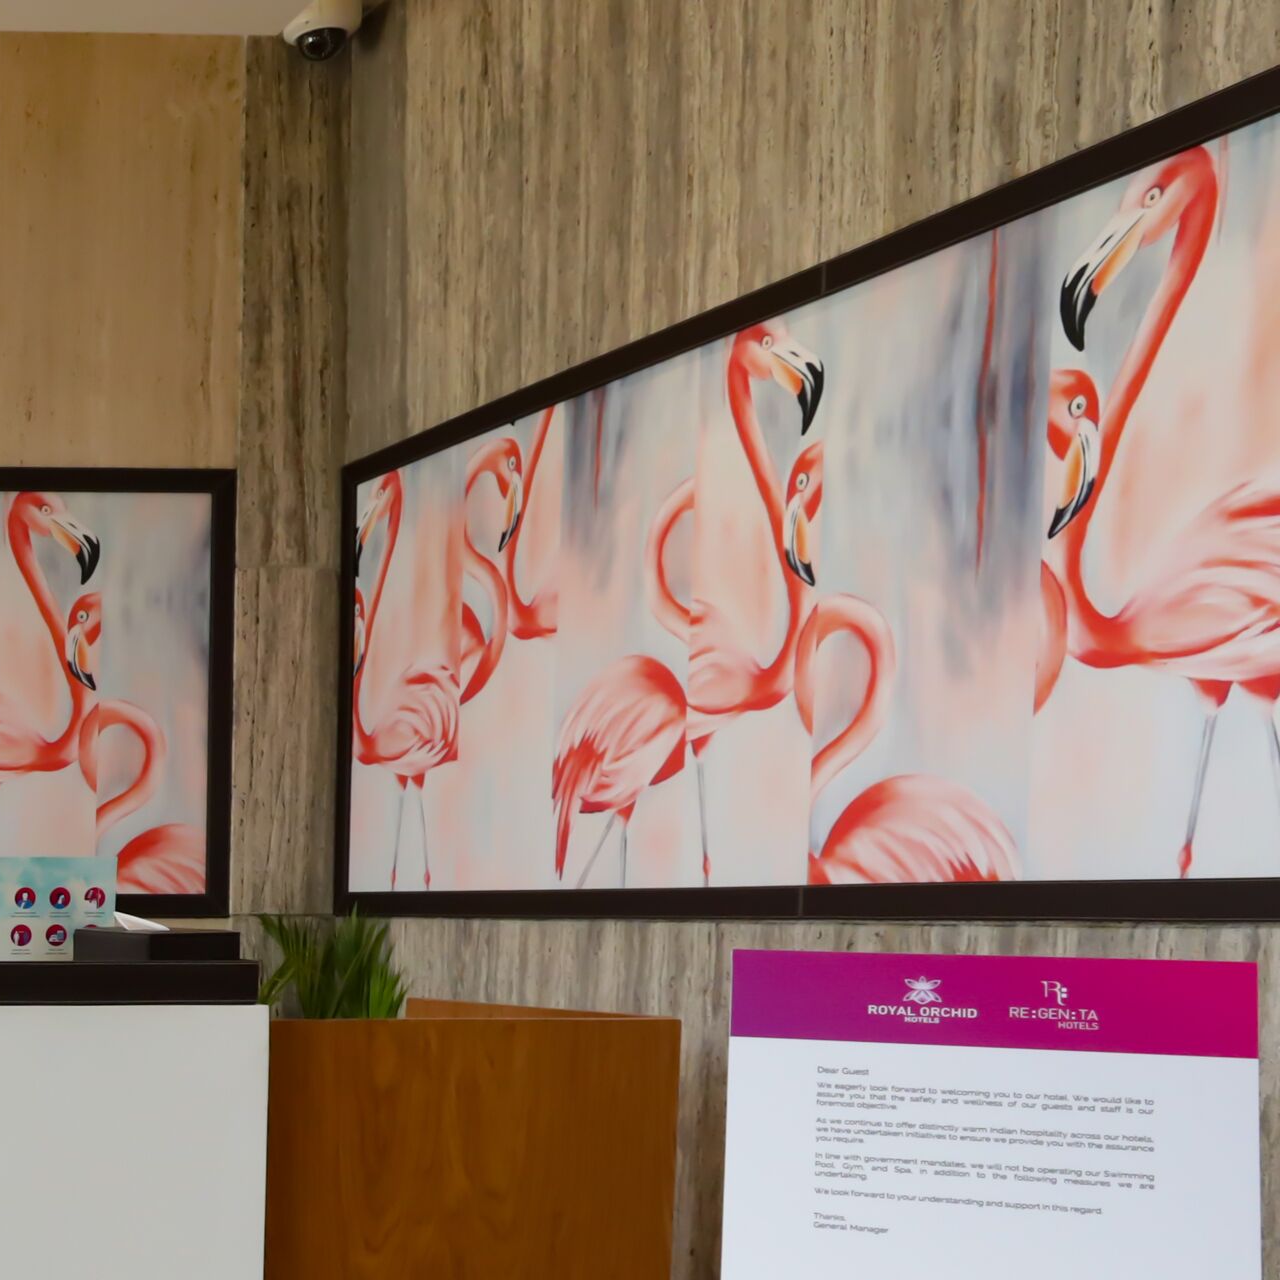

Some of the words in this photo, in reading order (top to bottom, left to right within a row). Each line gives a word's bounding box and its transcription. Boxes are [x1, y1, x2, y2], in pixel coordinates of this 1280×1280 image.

[868, 1004, 915, 1017] ROYAL
[920, 1006, 978, 1018] ORCHID
[904, 1016, 940, 1024] HOTELS
[1058, 1021, 1099, 1030] HOTELS
[816, 1066, 839, 1075] Dear
[842, 1067, 870, 1076] Guest
[834, 1083, 866, 1093] eagerly
[871, 1084, 887, 1092] look
[891, 1085, 925, 1094] forward
[941, 1088, 989, 1099] welcoming
[994, 1092, 1009, 1100] you
[1093, 1096, 1121, 1104] would
[1125, 1097, 1140, 1105] like
[815, 1099, 855, 1108] foremost
[849, 1094, 865, 1102] you
[869, 1093, 886, 1102] that
[890, 1094, 905, 1102] the
[909, 1096, 936, 1106] safety
[962, 1098, 1002, 1107] wellness
[1040, 1103, 1073, 1113] guests
[1077, 1104, 1095, 1112] and
[1099, 1105, 1121, 1114] staff
[844, 1119, 882, 1128] continue
[895, 1121, 916, 1130] offer
[918, 1122, 958, 1134] distinctly
[962, 1126, 987, 1134] warm
[989, 1126, 1017, 1135] Indian
[1019, 1128, 1067, 1140] hospitality
[1070, 1132, 1101, 1140] across
[816, 1135, 831, 1144] you
[830, 1126, 851, 1135] have
[853, 1128, 903, 1138] undertaken
[905, 1131, 946, 1140] initiatives
[959, 1135, 991, 1143] ensure
[1008, 1138, 1044, 1148] provide
[1046, 1140, 1063, 1149] you
[1065, 1140, 1085, 1149] with
[1087, 1141, 1103, 1150] the
[1105, 1144, 1154, 1153] assurance
[824, 1152, 840, 1161] line
[843, 1154, 862, 1162] with
[863, 1156, 918, 1167] government
[985, 1163, 1002, 1171] will
[1003, 1164, 1020, 1172] not
[1036, 1167, 1082, 1177] operating
[1103, 1170, 1155, 1182] Swimming
[871, 1165, 888, 1173] and
[933, 1169, 970, 1178] addition
[992, 1172, 1007, 1181] the
[1013, 1174, 1057, 1185] following
[1063, 1178, 1110, 1187] measures
[830, 1188, 848, 1197] look
[850, 1190, 884, 1200] forward
[897, 1194, 916, 1203] your
[918, 1195, 984, 1208] understanding
[985, 1200, 1003, 1208] and
[1004, 1202, 1040, 1212] support
[1051, 1204, 1068, 1212] this
[813, 1222, 847, 1231] General
[849, 1224, 888, 1235] Manager
